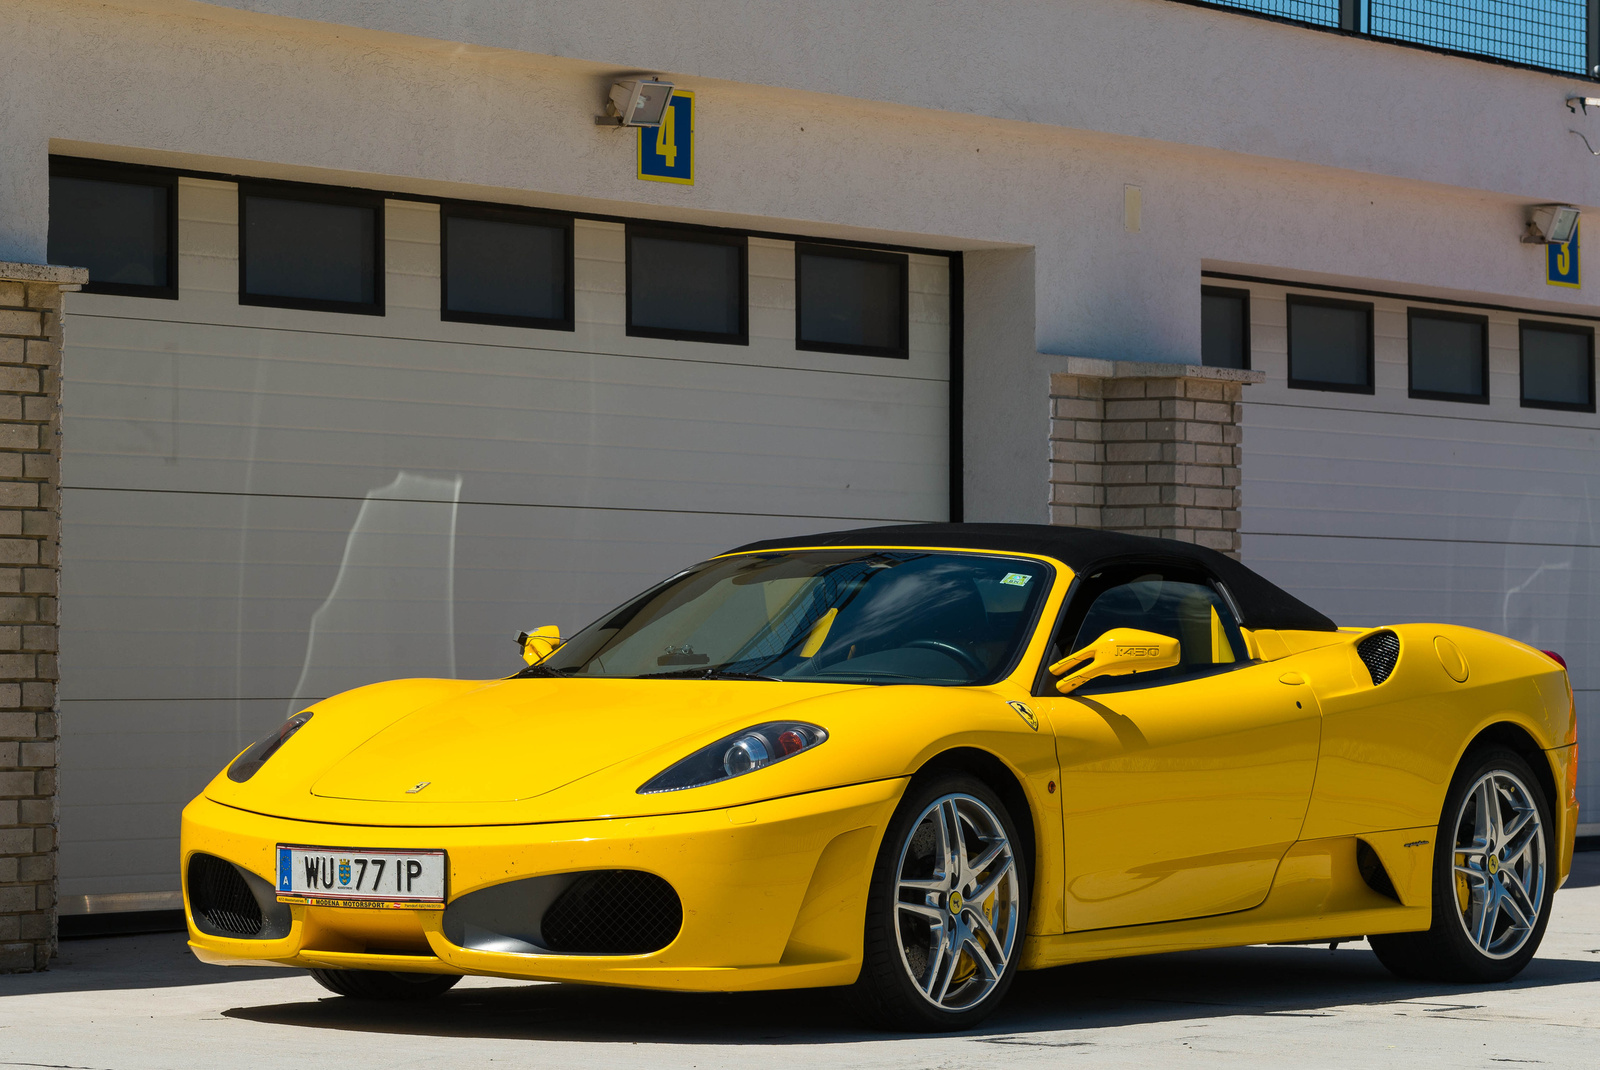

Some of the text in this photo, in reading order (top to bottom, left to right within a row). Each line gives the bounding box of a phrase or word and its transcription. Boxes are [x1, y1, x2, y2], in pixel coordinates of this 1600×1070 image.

[655, 105, 677, 167] 4
[1557, 241, 1570, 276] 3
[282, 875, 289, 886] A
[304, 855, 423, 892] WU 77 IP
